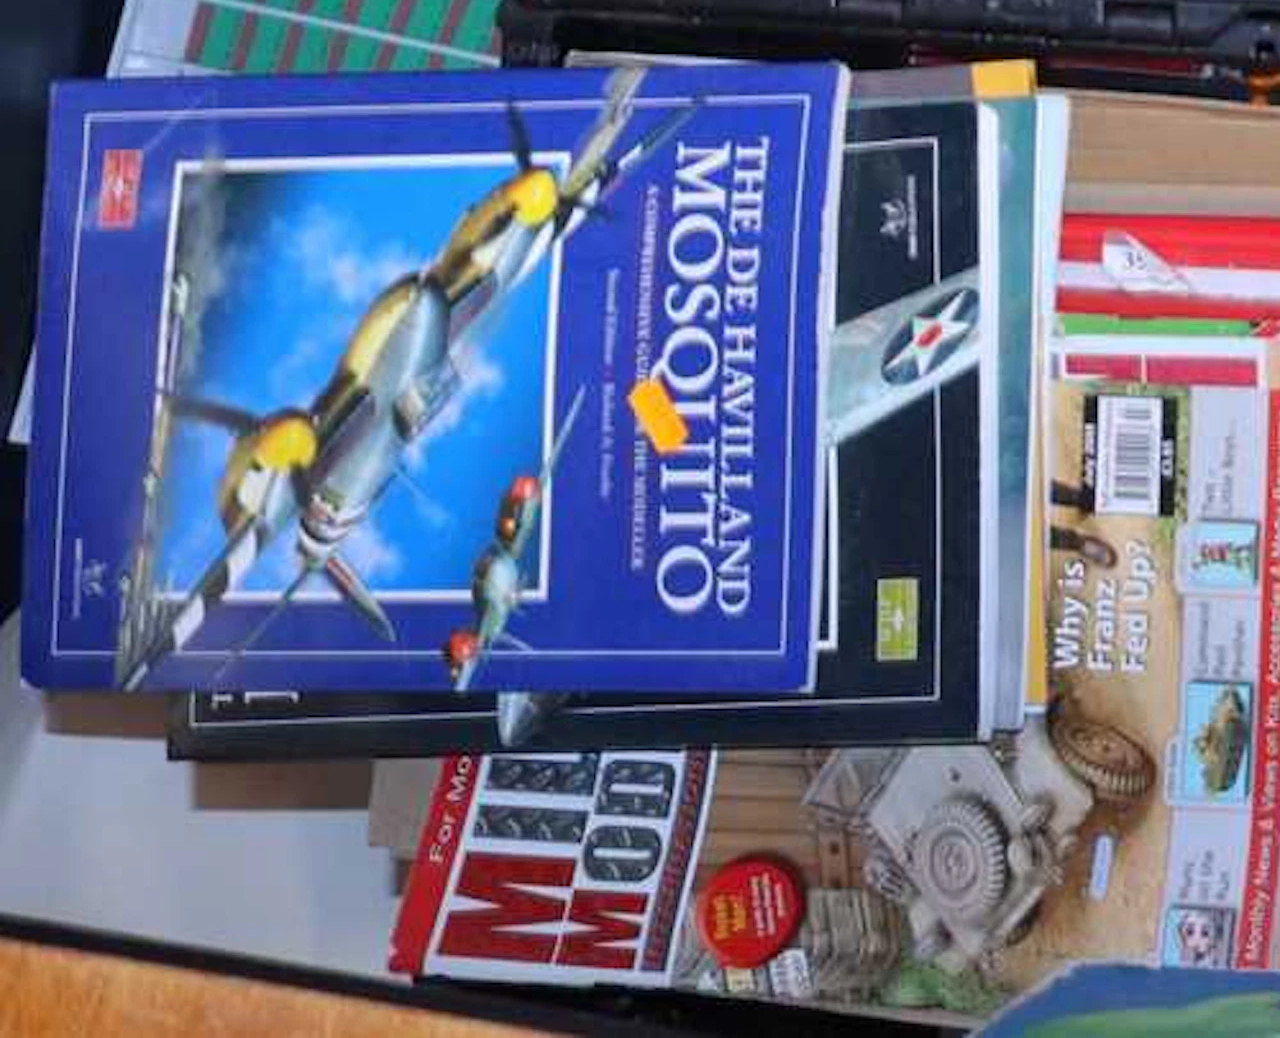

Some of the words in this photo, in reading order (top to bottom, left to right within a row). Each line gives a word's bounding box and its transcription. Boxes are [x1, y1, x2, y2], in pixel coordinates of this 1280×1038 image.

[729, 136, 771, 235] THE
[725, 245, 760, 312] DE
[713, 324, 756, 617] HAVILLAND
[1058, 559, 1086, 588] is
[1124, 539, 1158, 601] Up?
[1052, 596, 1087, 670] Why
[1088, 578, 1118, 672] Franz
[1120, 611, 1149, 673] Fed
[1257, 759, 1280, 812] Views
[428, 812, 460, 864] For
[1252, 831, 1273, 886] News
[1244, 889, 1272, 961] Monthly
